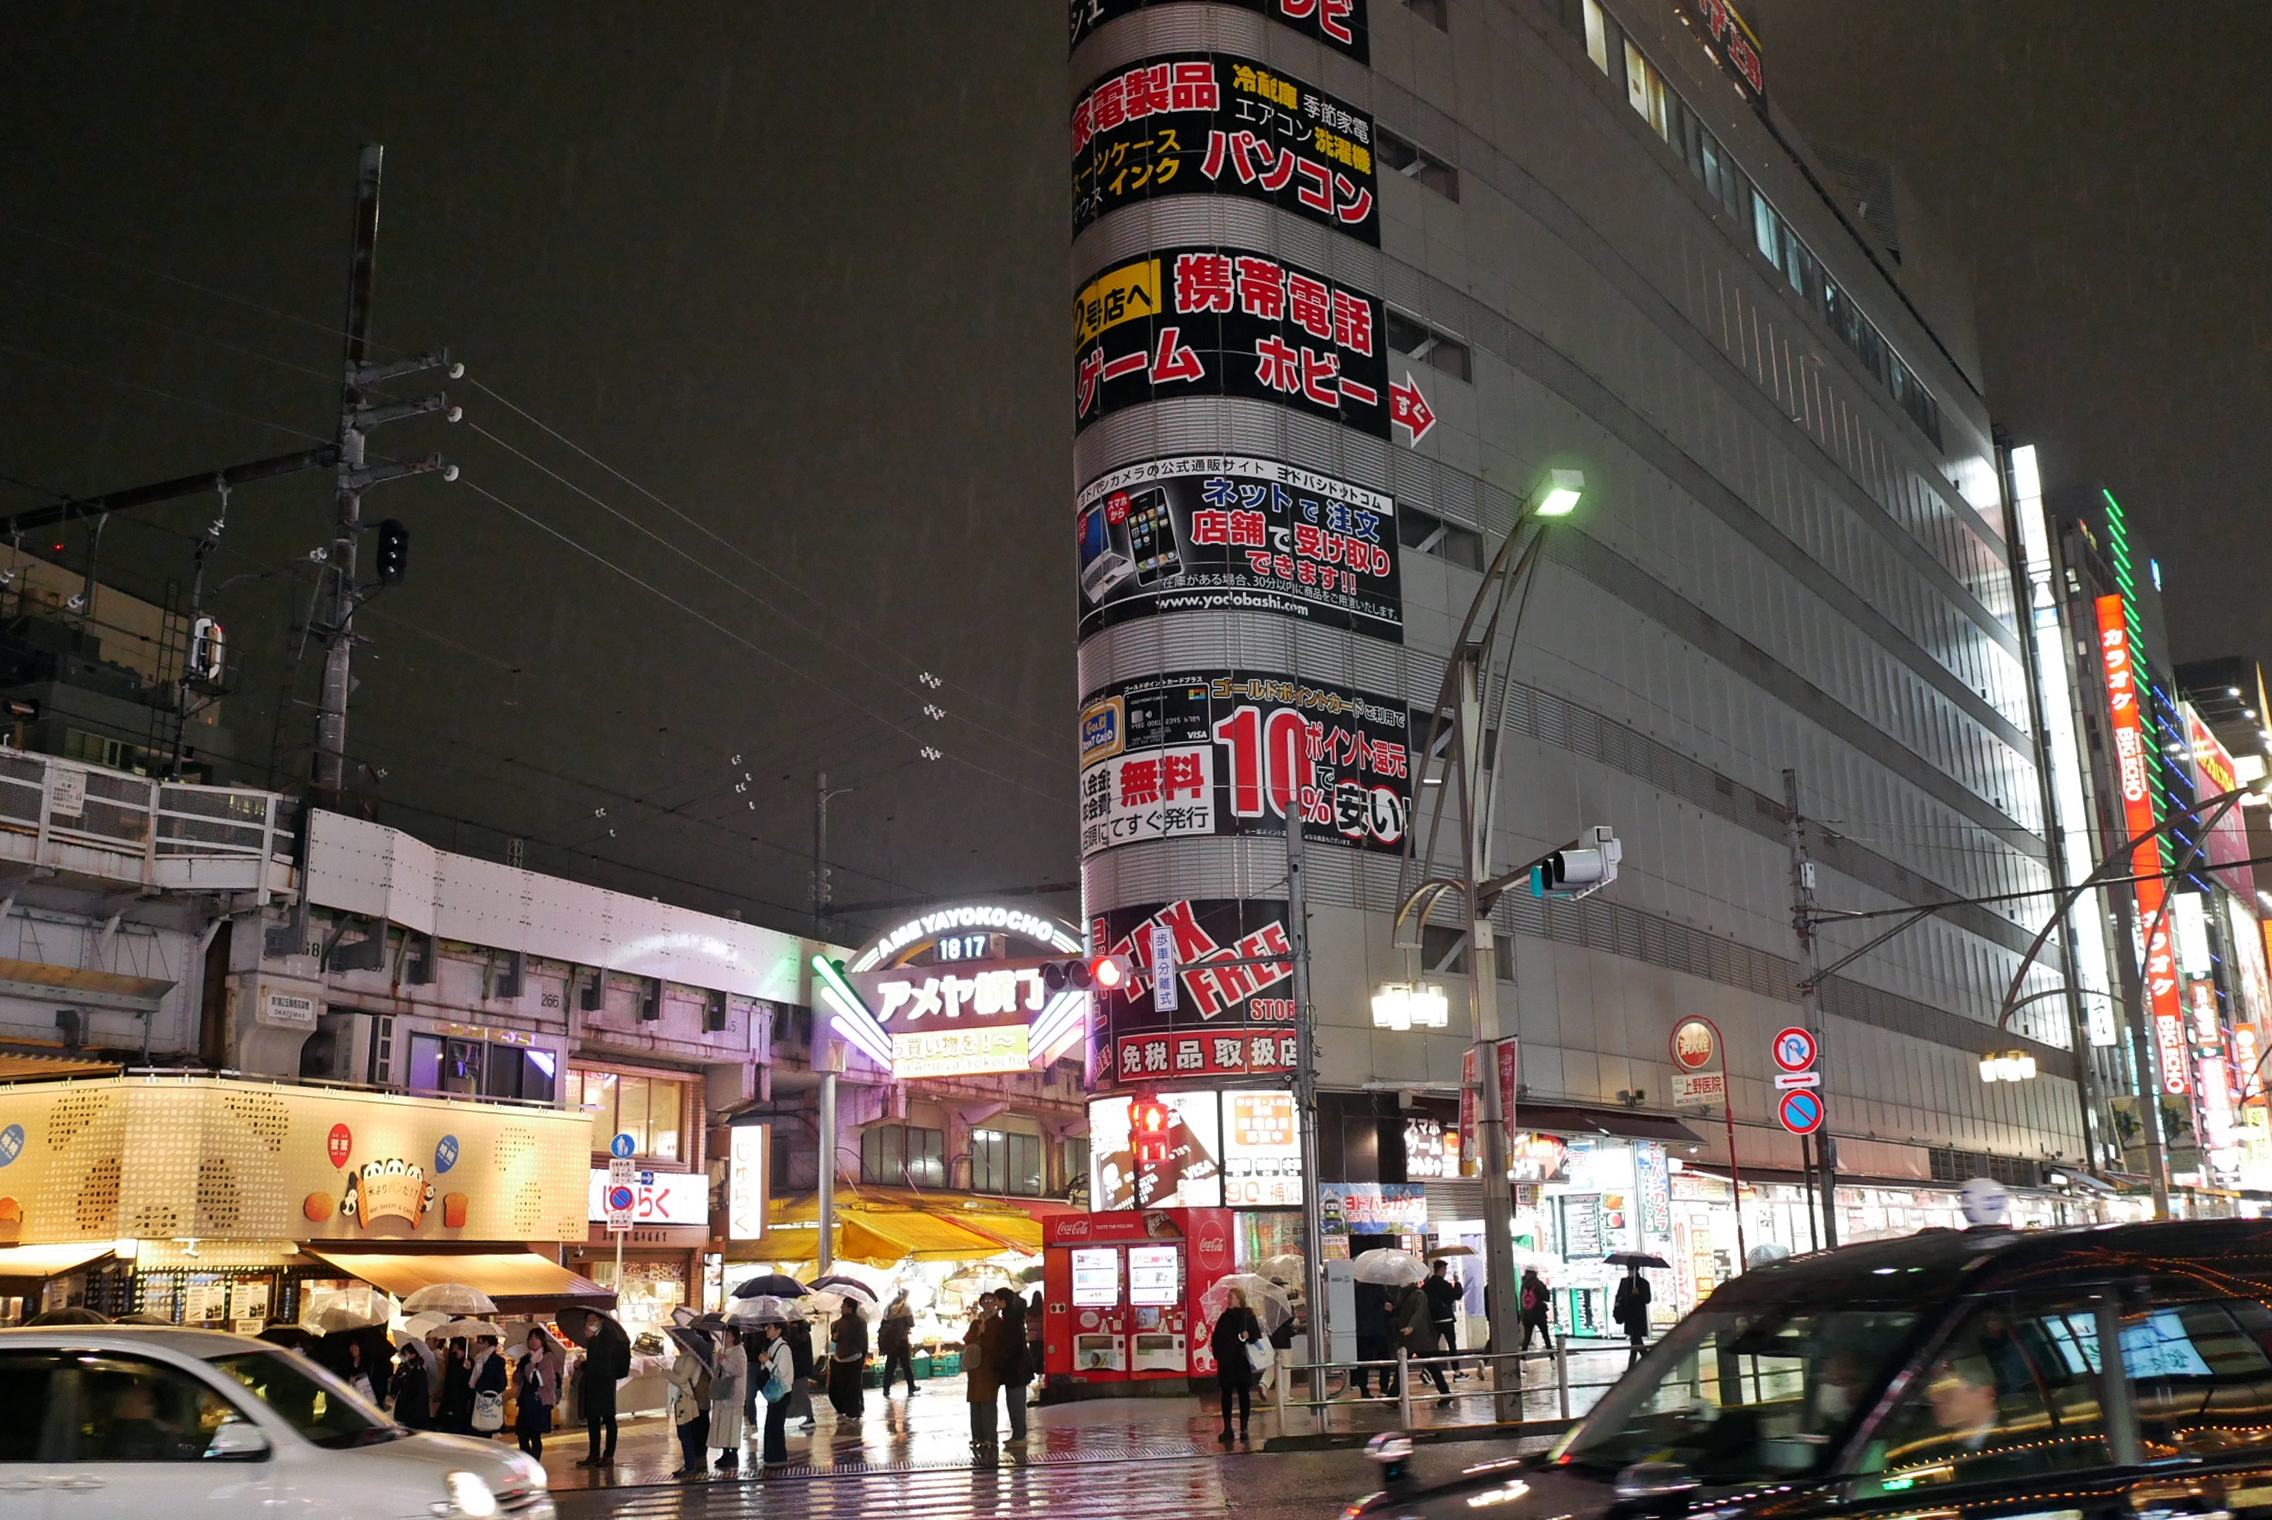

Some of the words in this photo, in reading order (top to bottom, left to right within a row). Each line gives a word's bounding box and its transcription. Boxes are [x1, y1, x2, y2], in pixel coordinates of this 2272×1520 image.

[1232, 64, 1298, 111] 冷蔵庫
[1072, 61, 1220, 161] 家電製品
[1236, 98, 1312, 141] エアコン
[1303, 93, 1370, 144] 季節家電
[1314, 126, 1372, 174] 洗濯機
[1108, 157, 1180, 195] インク
[1201, 130, 1373, 224] パソコン
[1074, 284, 1153, 348] 2号店へ
[1174, 253, 1373, 357] 携帯電話
[1077, 327, 1205, 419] ゲーム
[1255, 334, 1378, 408] ホビー
[1396, 395, 1426, 424] すぐ
[1080, 459, 1264, 509] ヨドバシカメラの公式通販サイト
[1277, 464, 1382, 510] ヨドバシドットコム
[1108, 496, 1128, 511] スマホ
[1110, 508, 1126, 521] から
[1203, 477, 1380, 542] ネットで注文
[1191, 509, 1390, 579] 店舗で受け取り
[1156, 591, 1309, 616] www.yodobashi.com
[2103, 628, 2133, 711] カラオケ
[1187, 731, 1208, 740] VISA
[1304, 721, 1408, 780] ポイント還元
[2115, 726, 2136, 758] BIG
[1120, 752, 1205, 807] 無料
[2124, 757, 2144, 802] ECHO
[878, 906, 1054, 959] AMEYAYOKOCHO
[1155, 932, 1173, 1006] 歩車分離式
[541, 993, 559, 1009] 266
[877, 967, 1045, 1023] アメヤ横丁
[1679, 1033, 1710, 1056] 消火栓
[2156, 1014, 2179, 1048] BIG
[1683, 1075, 1723, 1096] 上野医院
[2165, 1047, 2185, 1094] ECHO
[1404, 1131, 1443, 1155] ゲーム
[1407, 1118, 1441, 1136] スマホ
[1181, 1159, 1216, 1180] VISA
[1057, 1220, 1089, 1236] Coca-Cola
[1200, 1237, 1224, 1252] Coca-Cola
[1577, 1289, 1588, 1330] FUJIFILM
